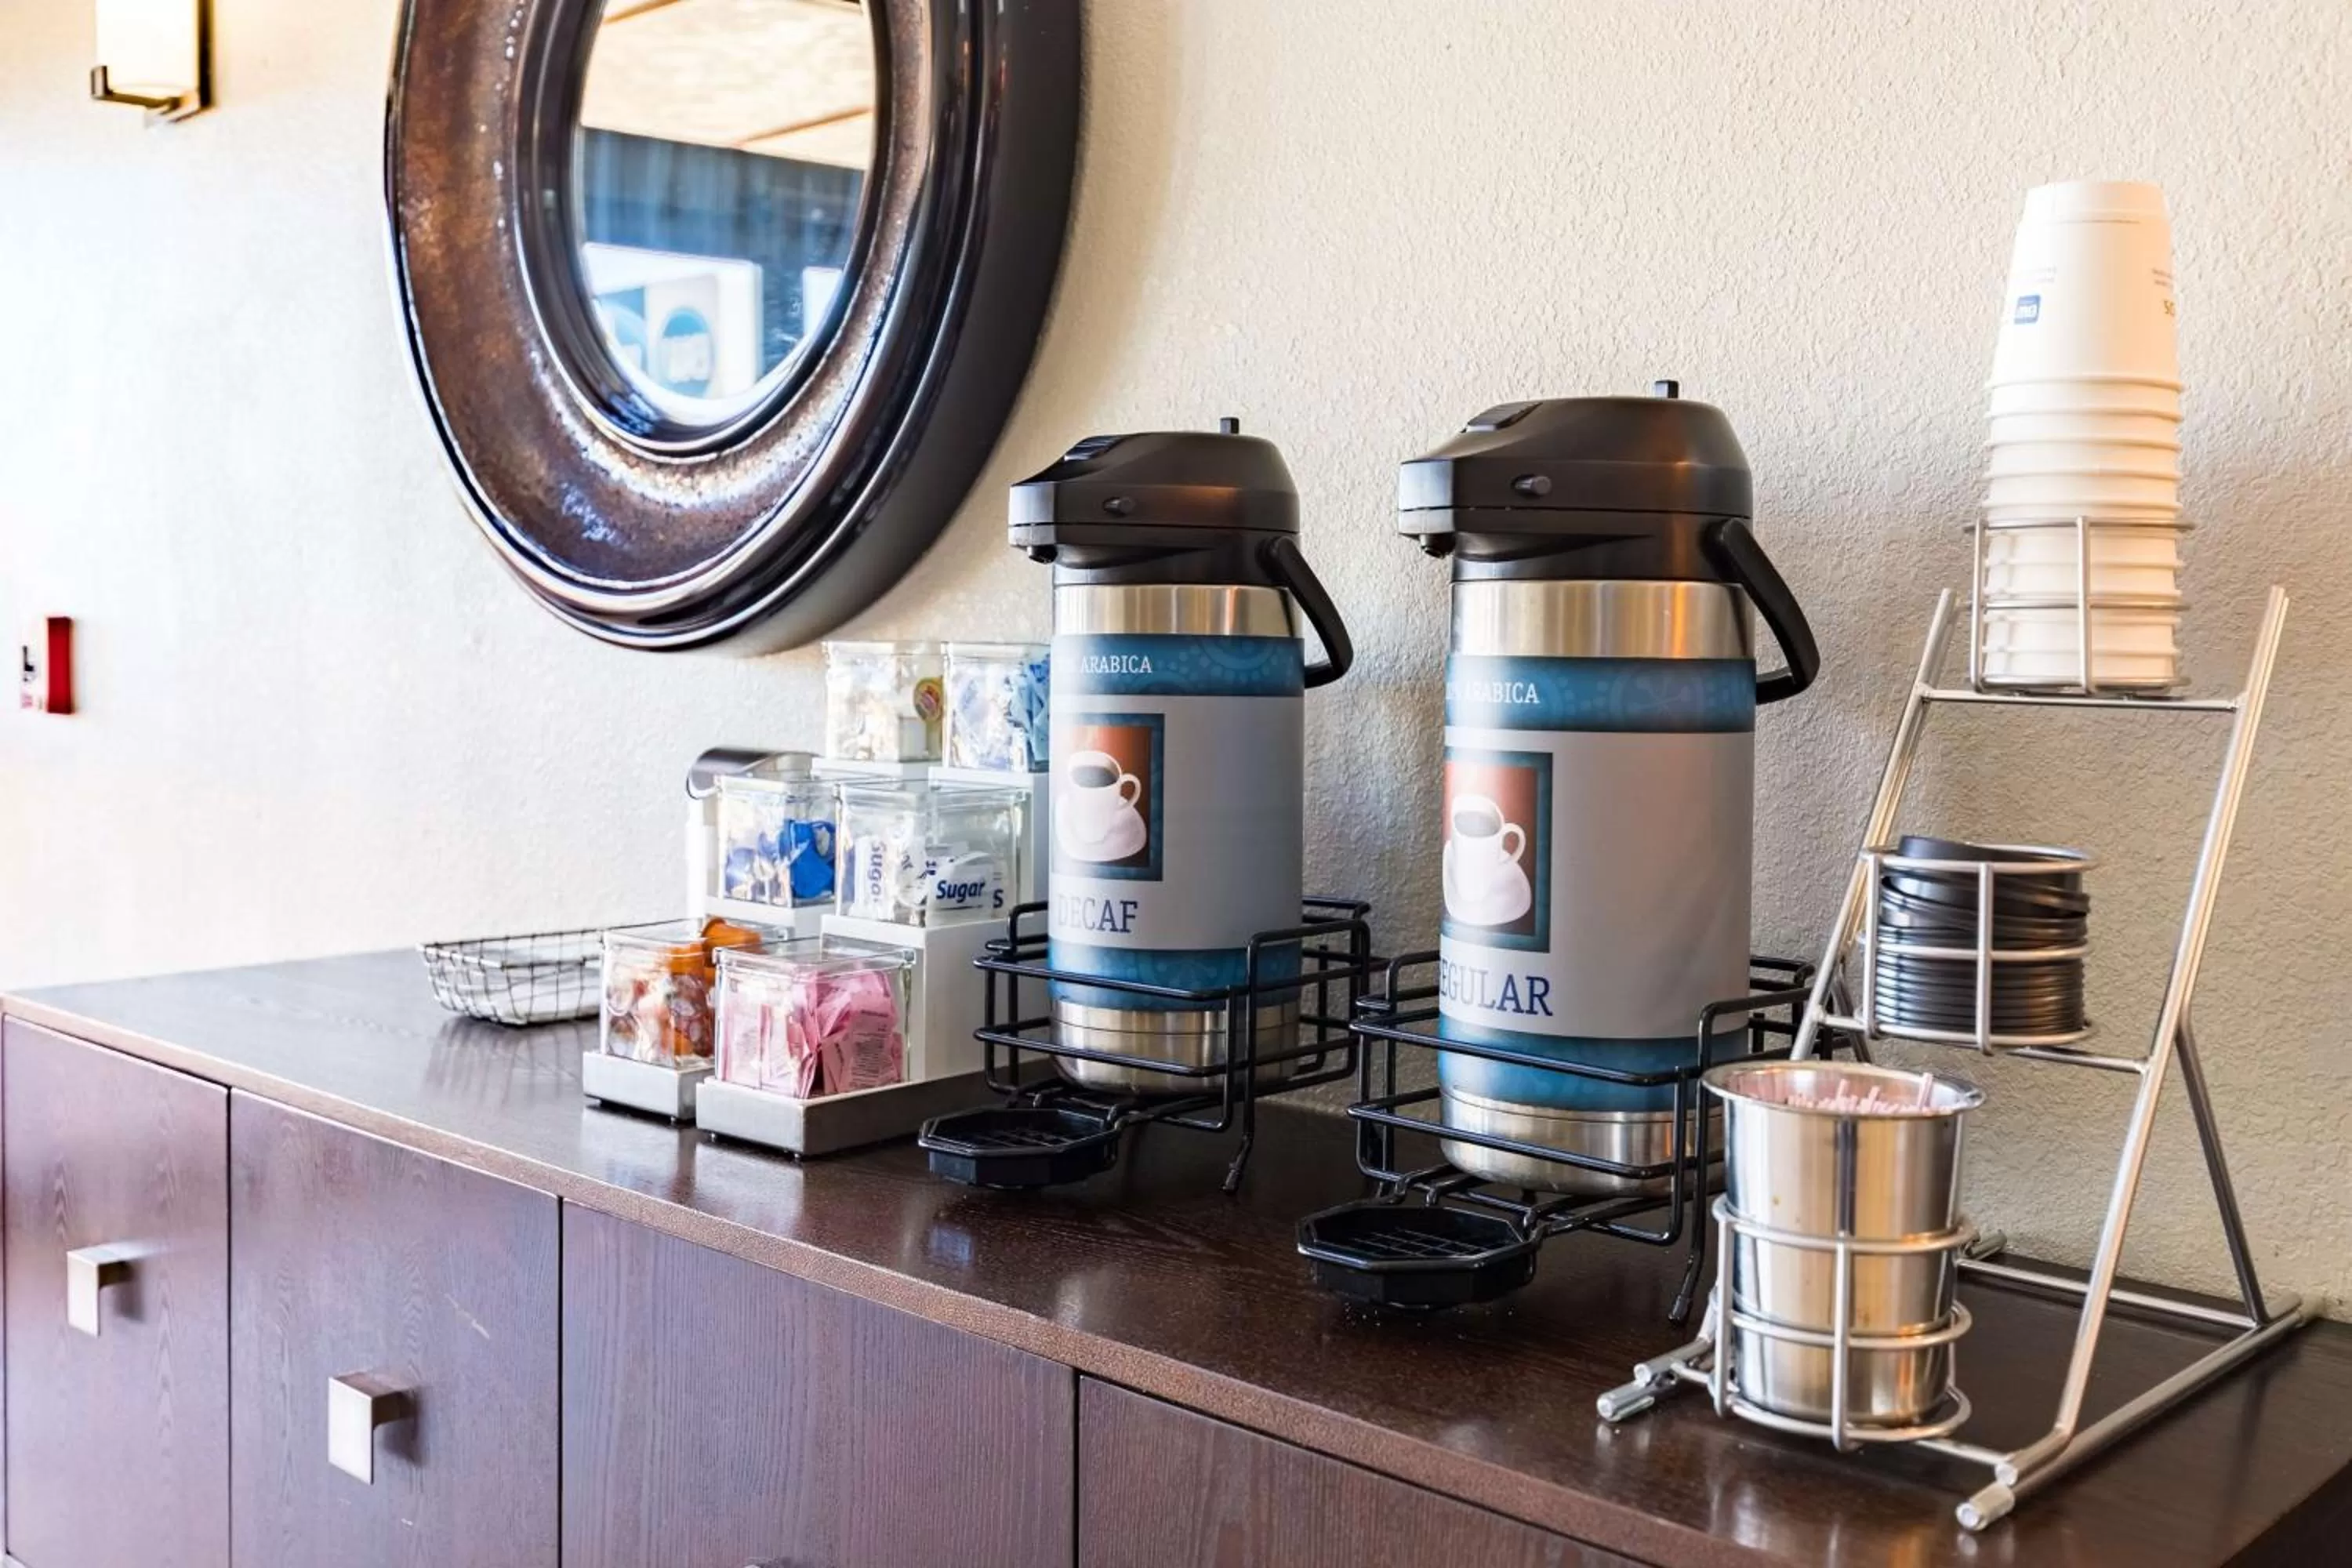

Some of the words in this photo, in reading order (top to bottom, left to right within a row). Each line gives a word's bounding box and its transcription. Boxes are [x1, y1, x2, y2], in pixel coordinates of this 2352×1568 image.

[1080, 654, 1152, 674] ARABICA
[867, 840, 887, 902] Suga
[936, 879, 986, 903] Sugar
[1056, 894, 1138, 934] DECAF
[1441, 957, 1553, 1016] EGULAR
